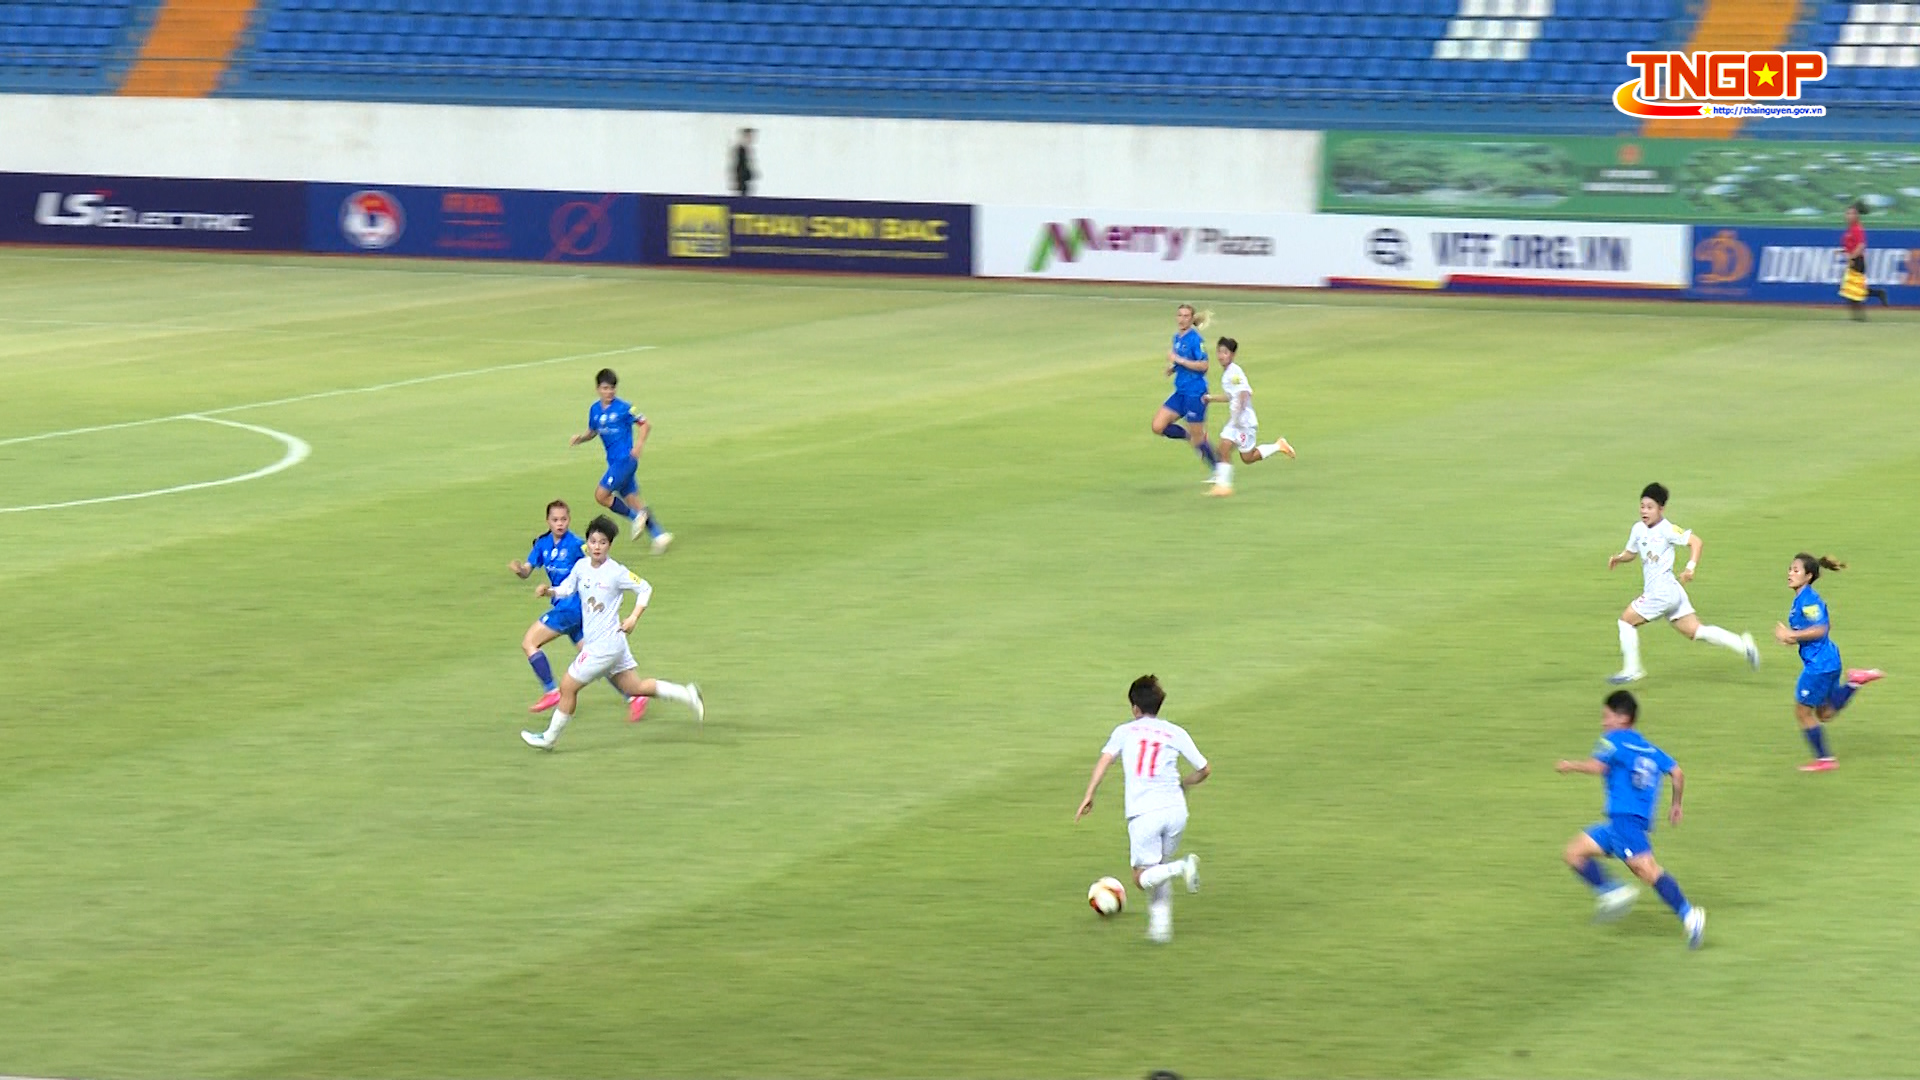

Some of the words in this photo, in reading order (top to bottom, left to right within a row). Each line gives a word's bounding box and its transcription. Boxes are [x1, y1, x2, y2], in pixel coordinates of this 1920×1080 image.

[34, 191, 106, 226] LS
[1027, 217, 1189, 272] Merry
[1197, 227, 1276, 257] Plaza
[1135, 738, 1163, 778] 11
